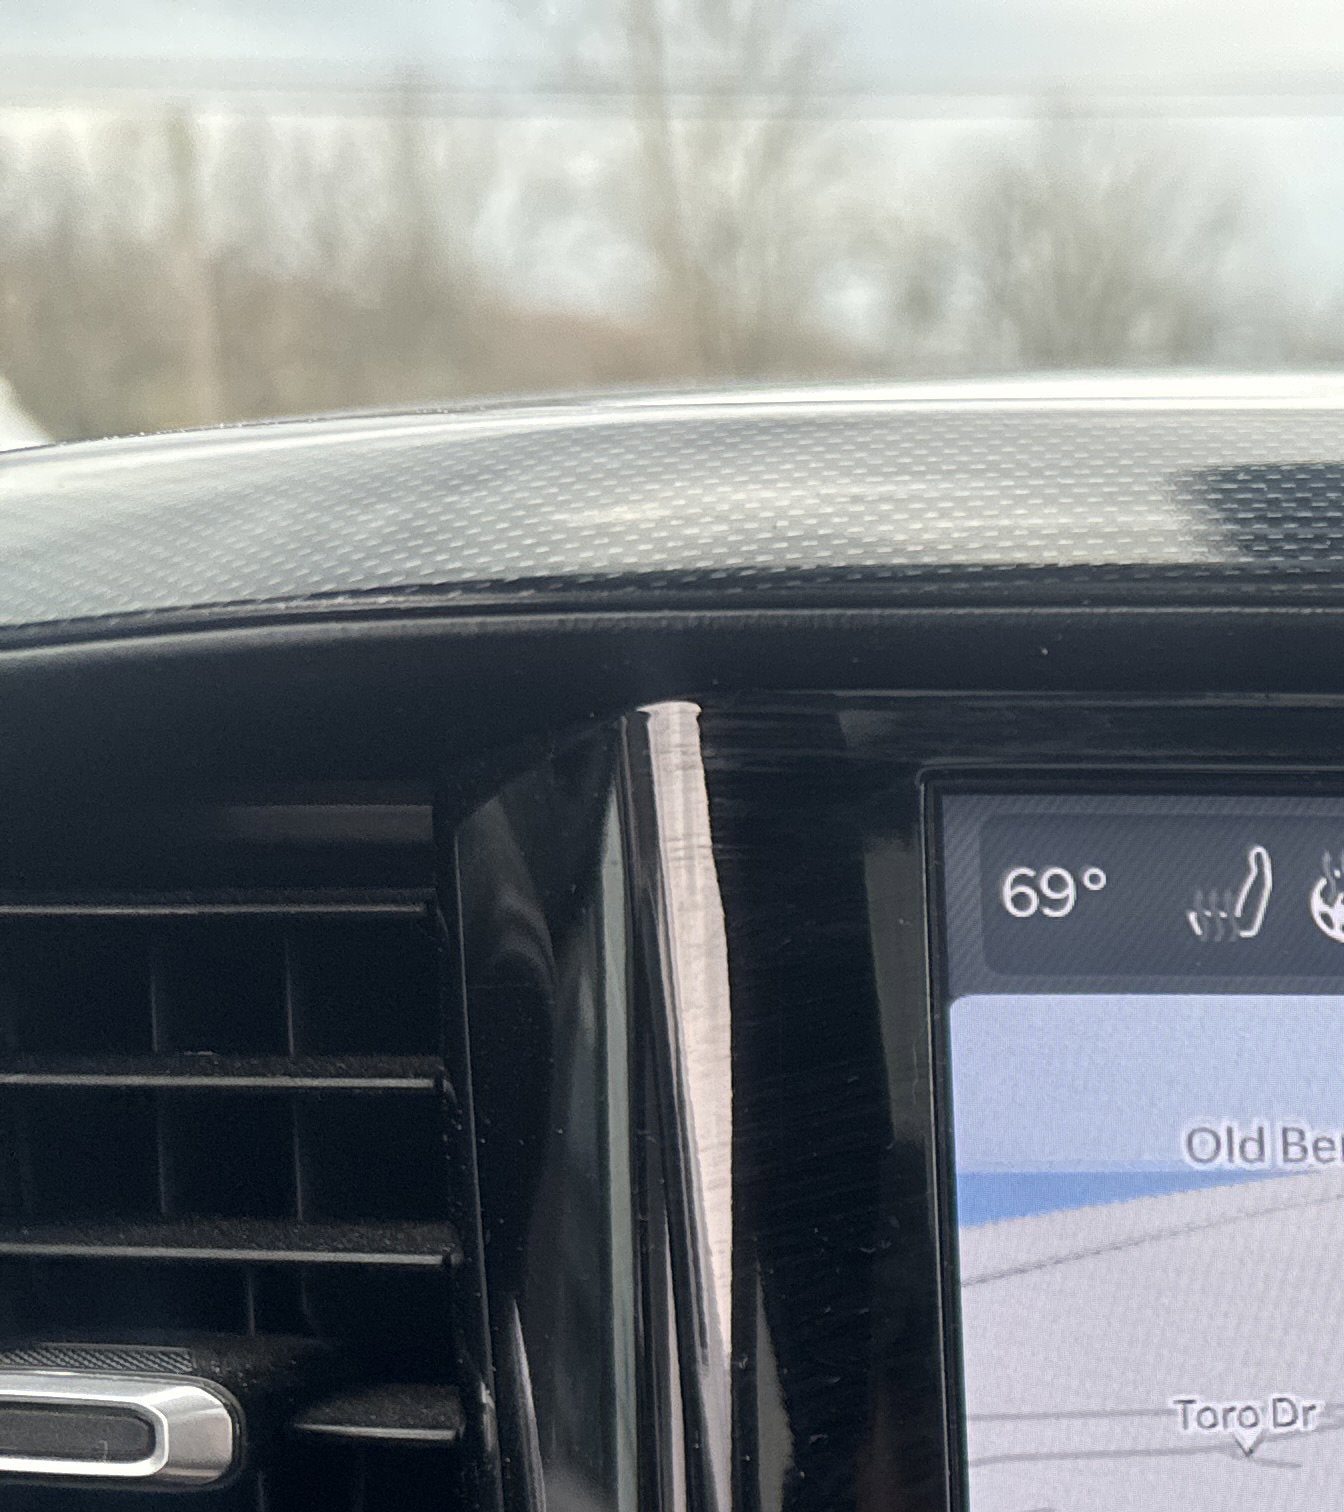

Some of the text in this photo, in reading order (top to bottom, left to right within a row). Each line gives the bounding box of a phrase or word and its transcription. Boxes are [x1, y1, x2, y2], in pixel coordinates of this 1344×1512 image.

[1002, 866, 1107, 917] 69°
[1186, 1125, 1266, 1164] Old
[1174, 1397, 1317, 1430] Toro Dr
